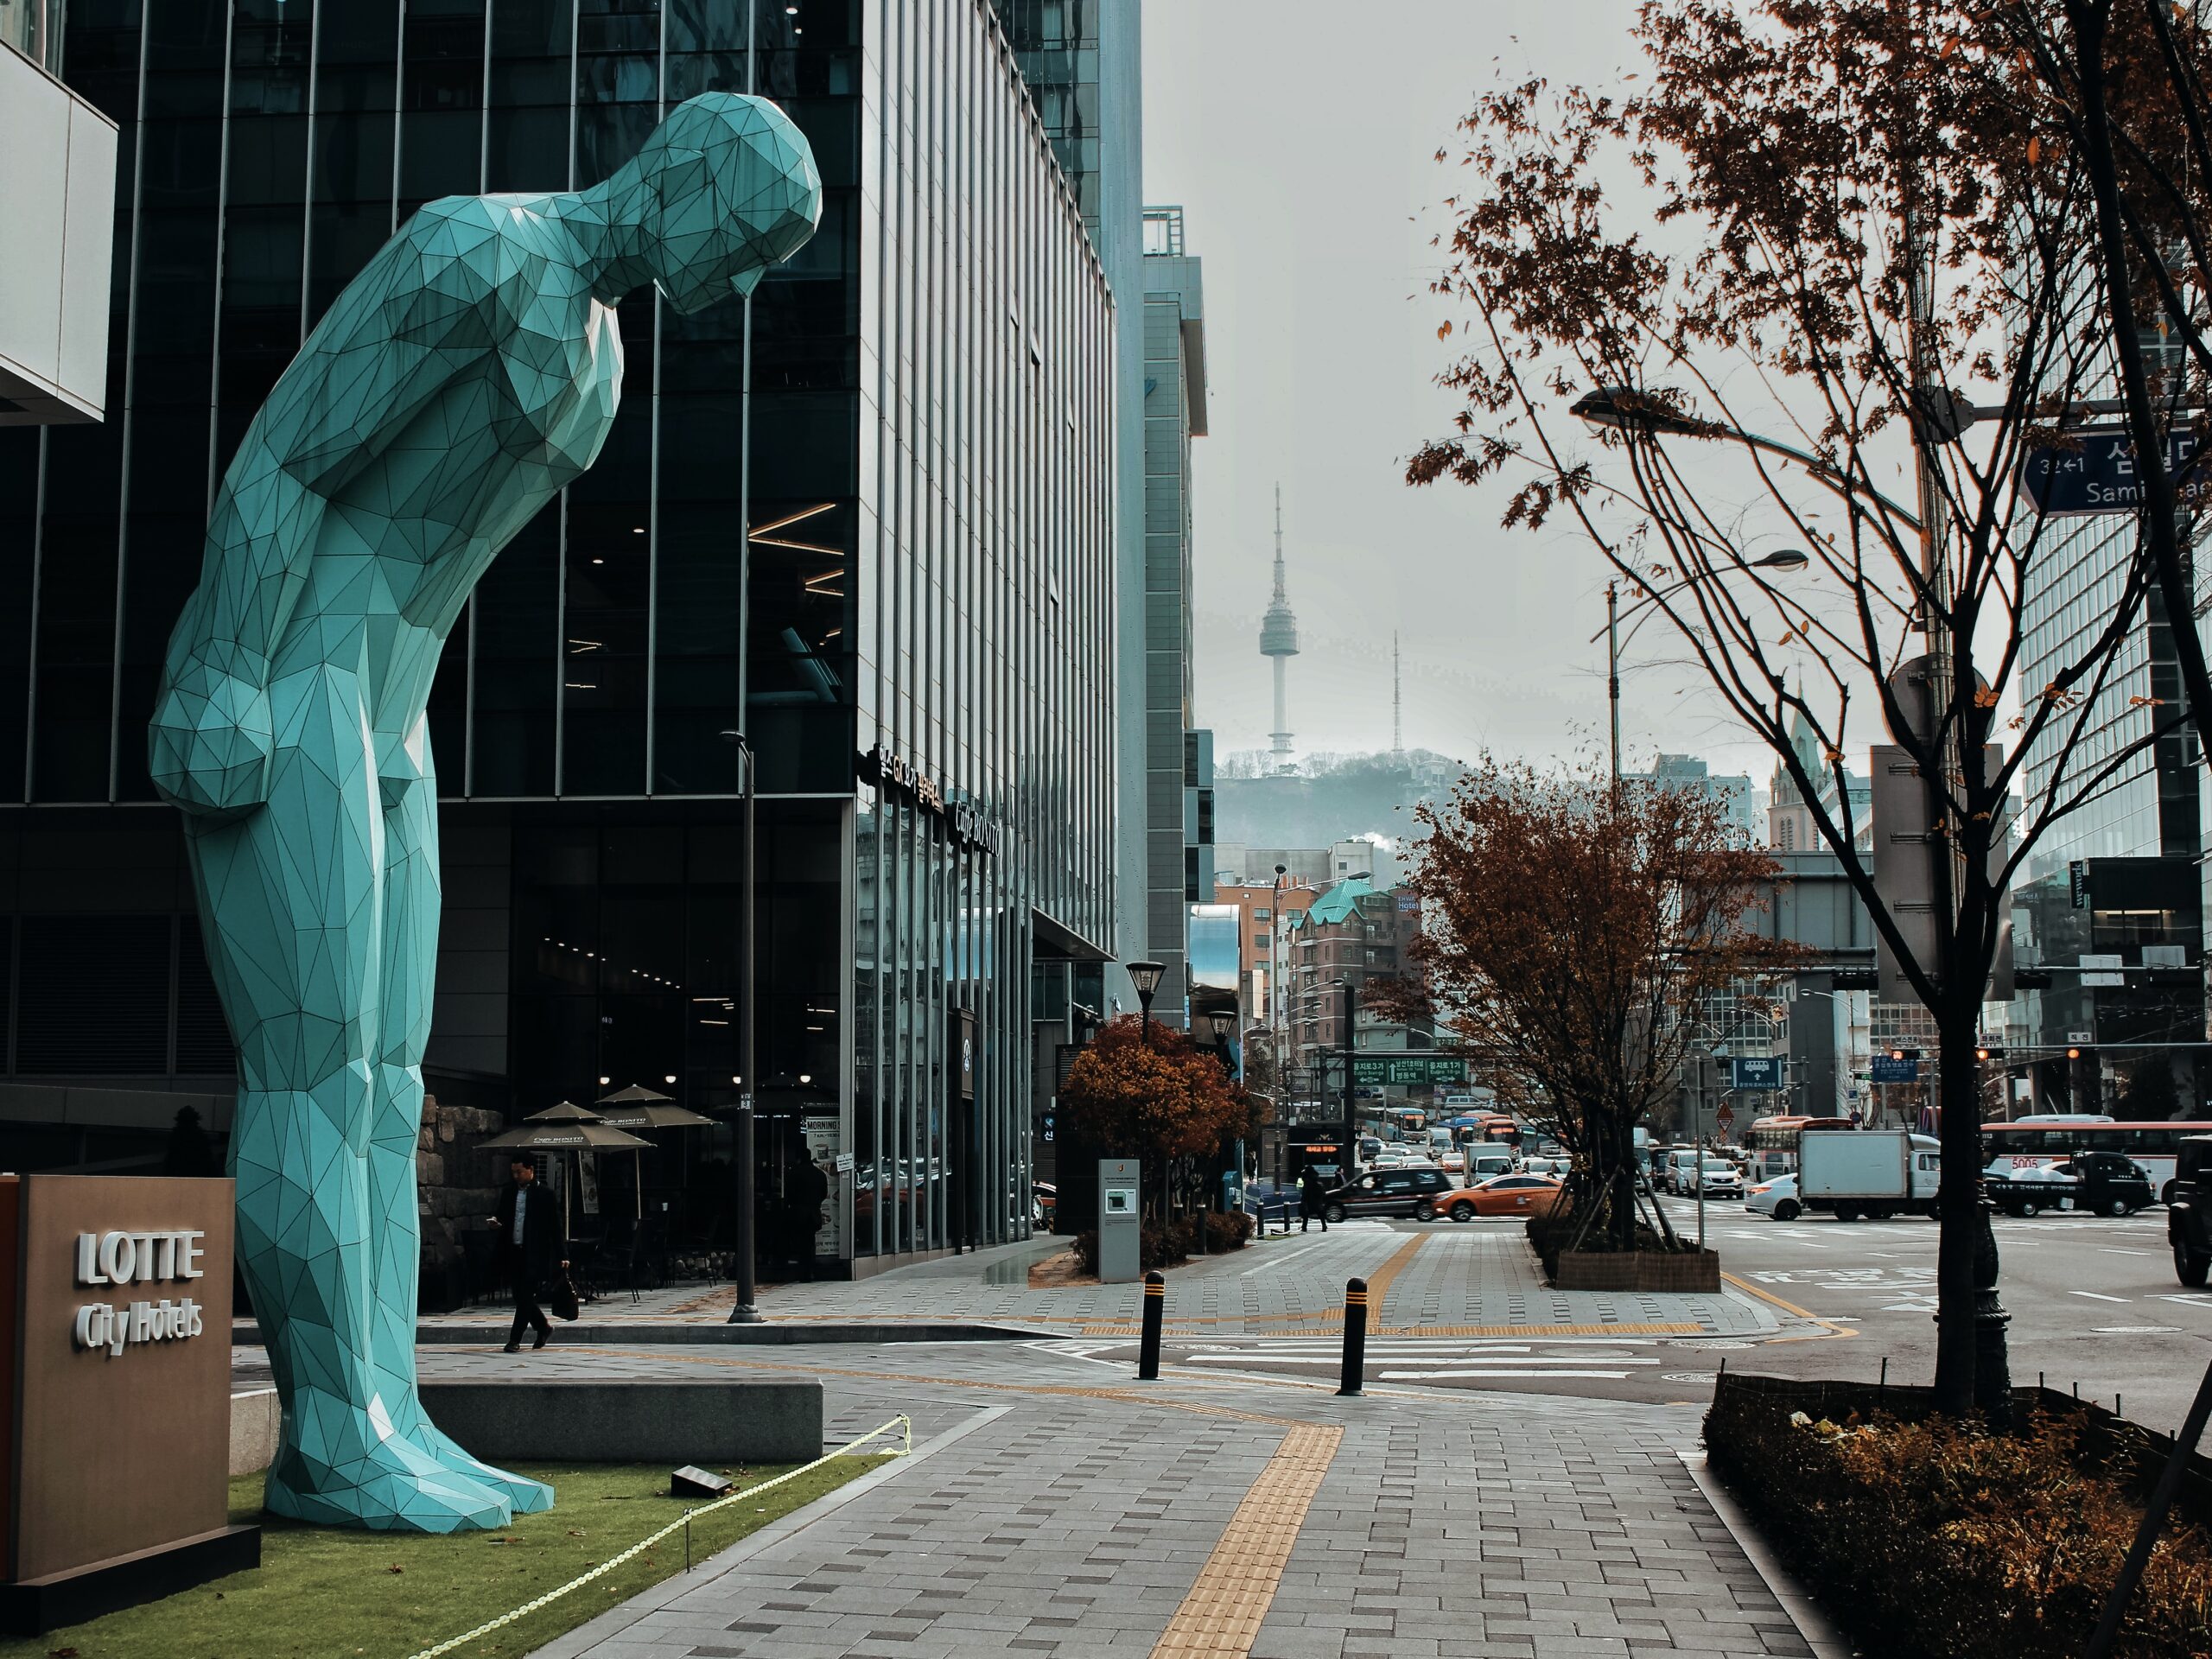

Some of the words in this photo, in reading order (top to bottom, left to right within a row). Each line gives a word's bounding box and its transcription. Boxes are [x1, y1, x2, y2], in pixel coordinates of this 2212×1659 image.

[973, 810, 1001, 857] BONITO
[2072, 864, 2083, 906] wework
[1354, 1062, 1383, 1071] 을지로3가
[807, 1121, 836, 1130] MORNING
[1044, 1130, 1053, 1141] 신
[2012, 1159, 2038, 1169] 5005
[78, 1230, 205, 1285] LOTTE
[76, 1302, 130, 1357] City
[129, 1298, 203, 1342] Hotels
